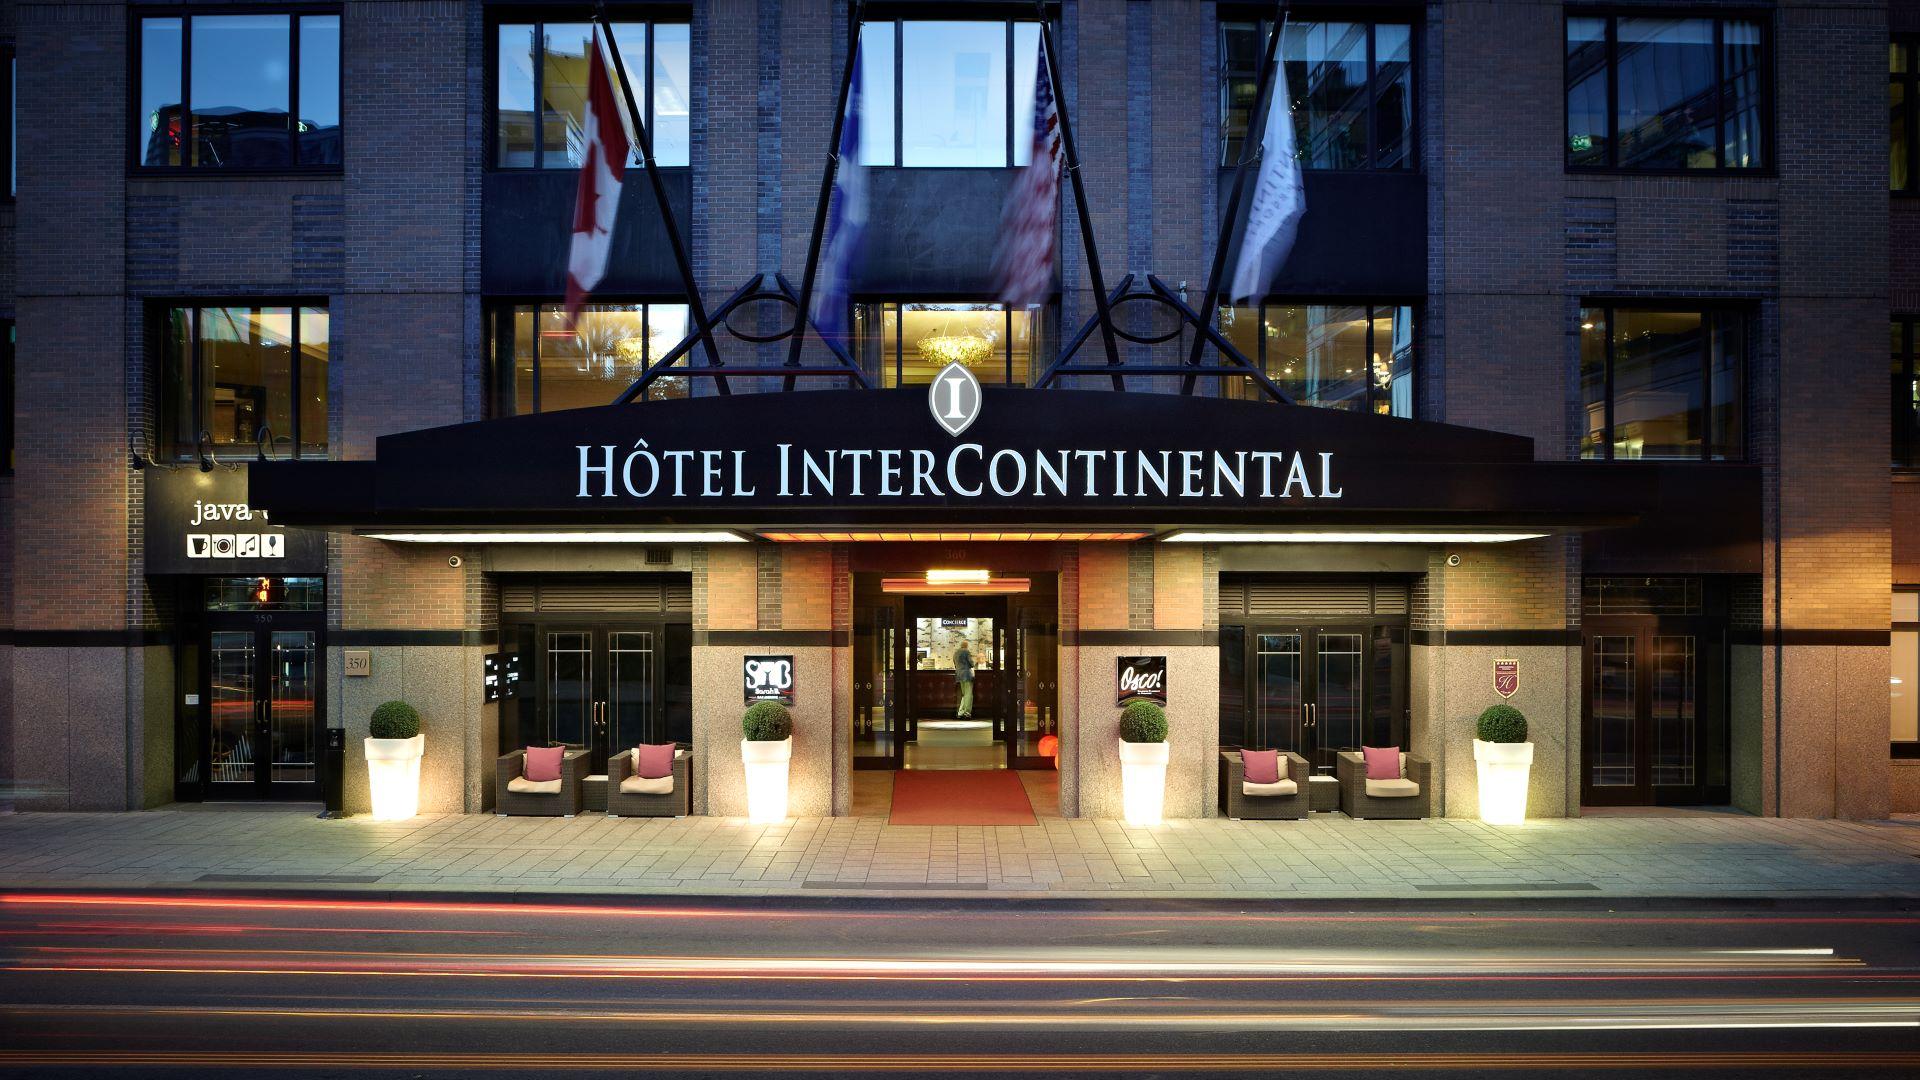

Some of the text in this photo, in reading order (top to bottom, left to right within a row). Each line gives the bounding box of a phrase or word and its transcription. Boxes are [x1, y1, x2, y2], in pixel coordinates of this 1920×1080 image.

[575, 438, 1343, 499] HÔTEL INTERCONTINENTAL
[255, 614, 273, 624] 350
[346, 658, 367, 670] 350
[1120, 666, 1164, 691] Osco!
